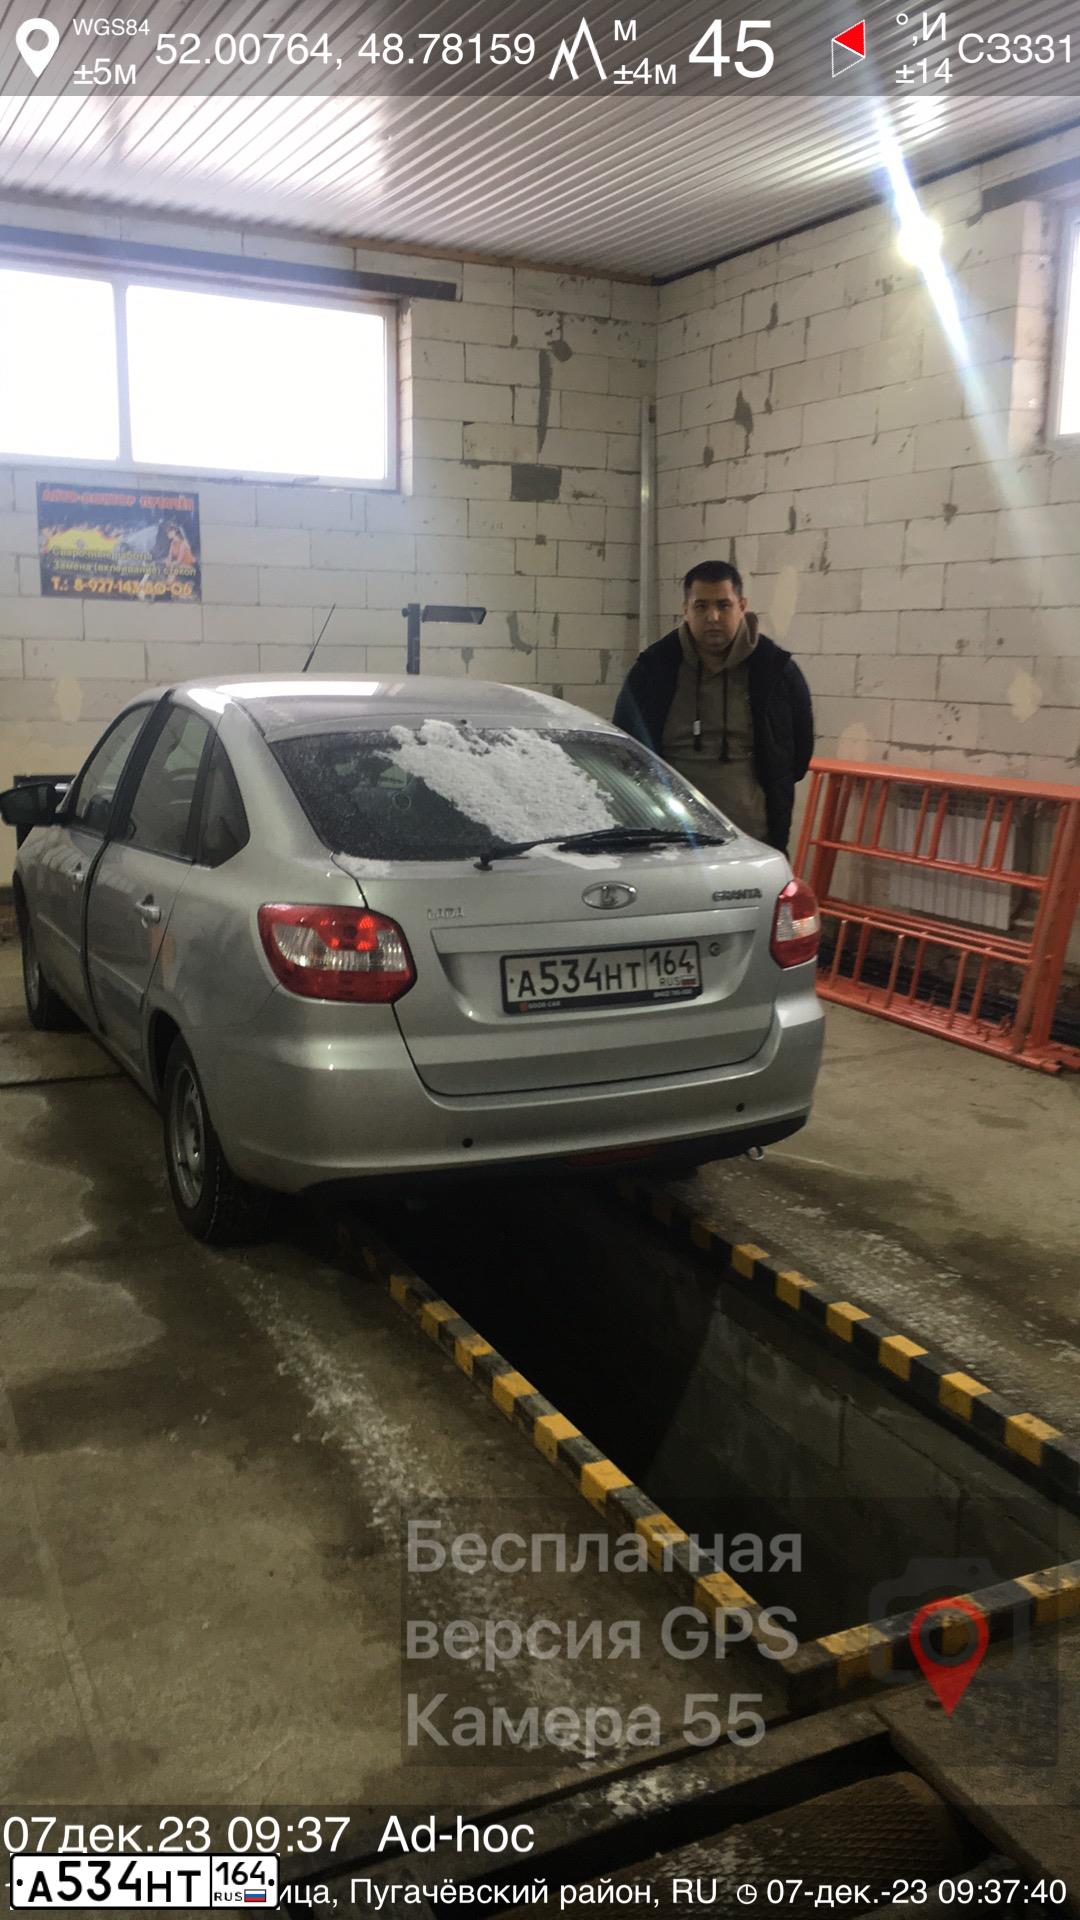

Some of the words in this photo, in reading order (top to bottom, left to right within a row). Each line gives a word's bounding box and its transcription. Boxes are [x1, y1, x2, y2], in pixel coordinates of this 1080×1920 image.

[517, 957, 642, 998] А534НТ
[649, 949, 695, 977] 164
[659, 976, 681, 987] RUS
